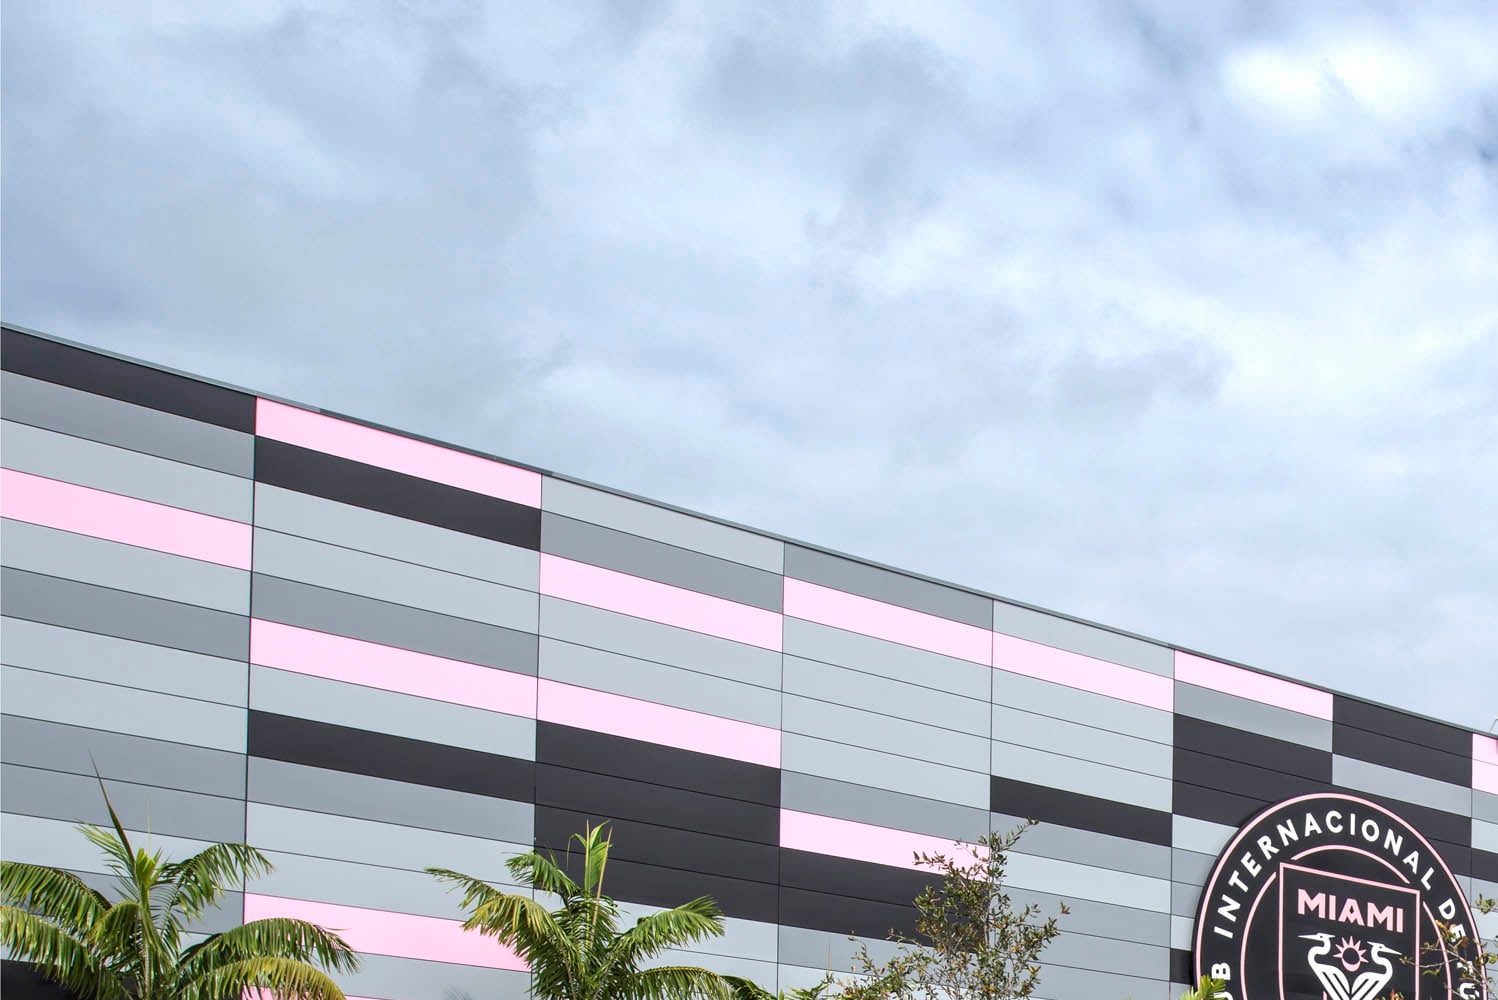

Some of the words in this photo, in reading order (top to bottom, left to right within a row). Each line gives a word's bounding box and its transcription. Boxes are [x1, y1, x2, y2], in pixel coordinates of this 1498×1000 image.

[1213, 810, 1437, 939] INTERNACIONAL
[1438, 898, 1467, 943] DE
[1297, 888, 1405, 933] MIAMI
